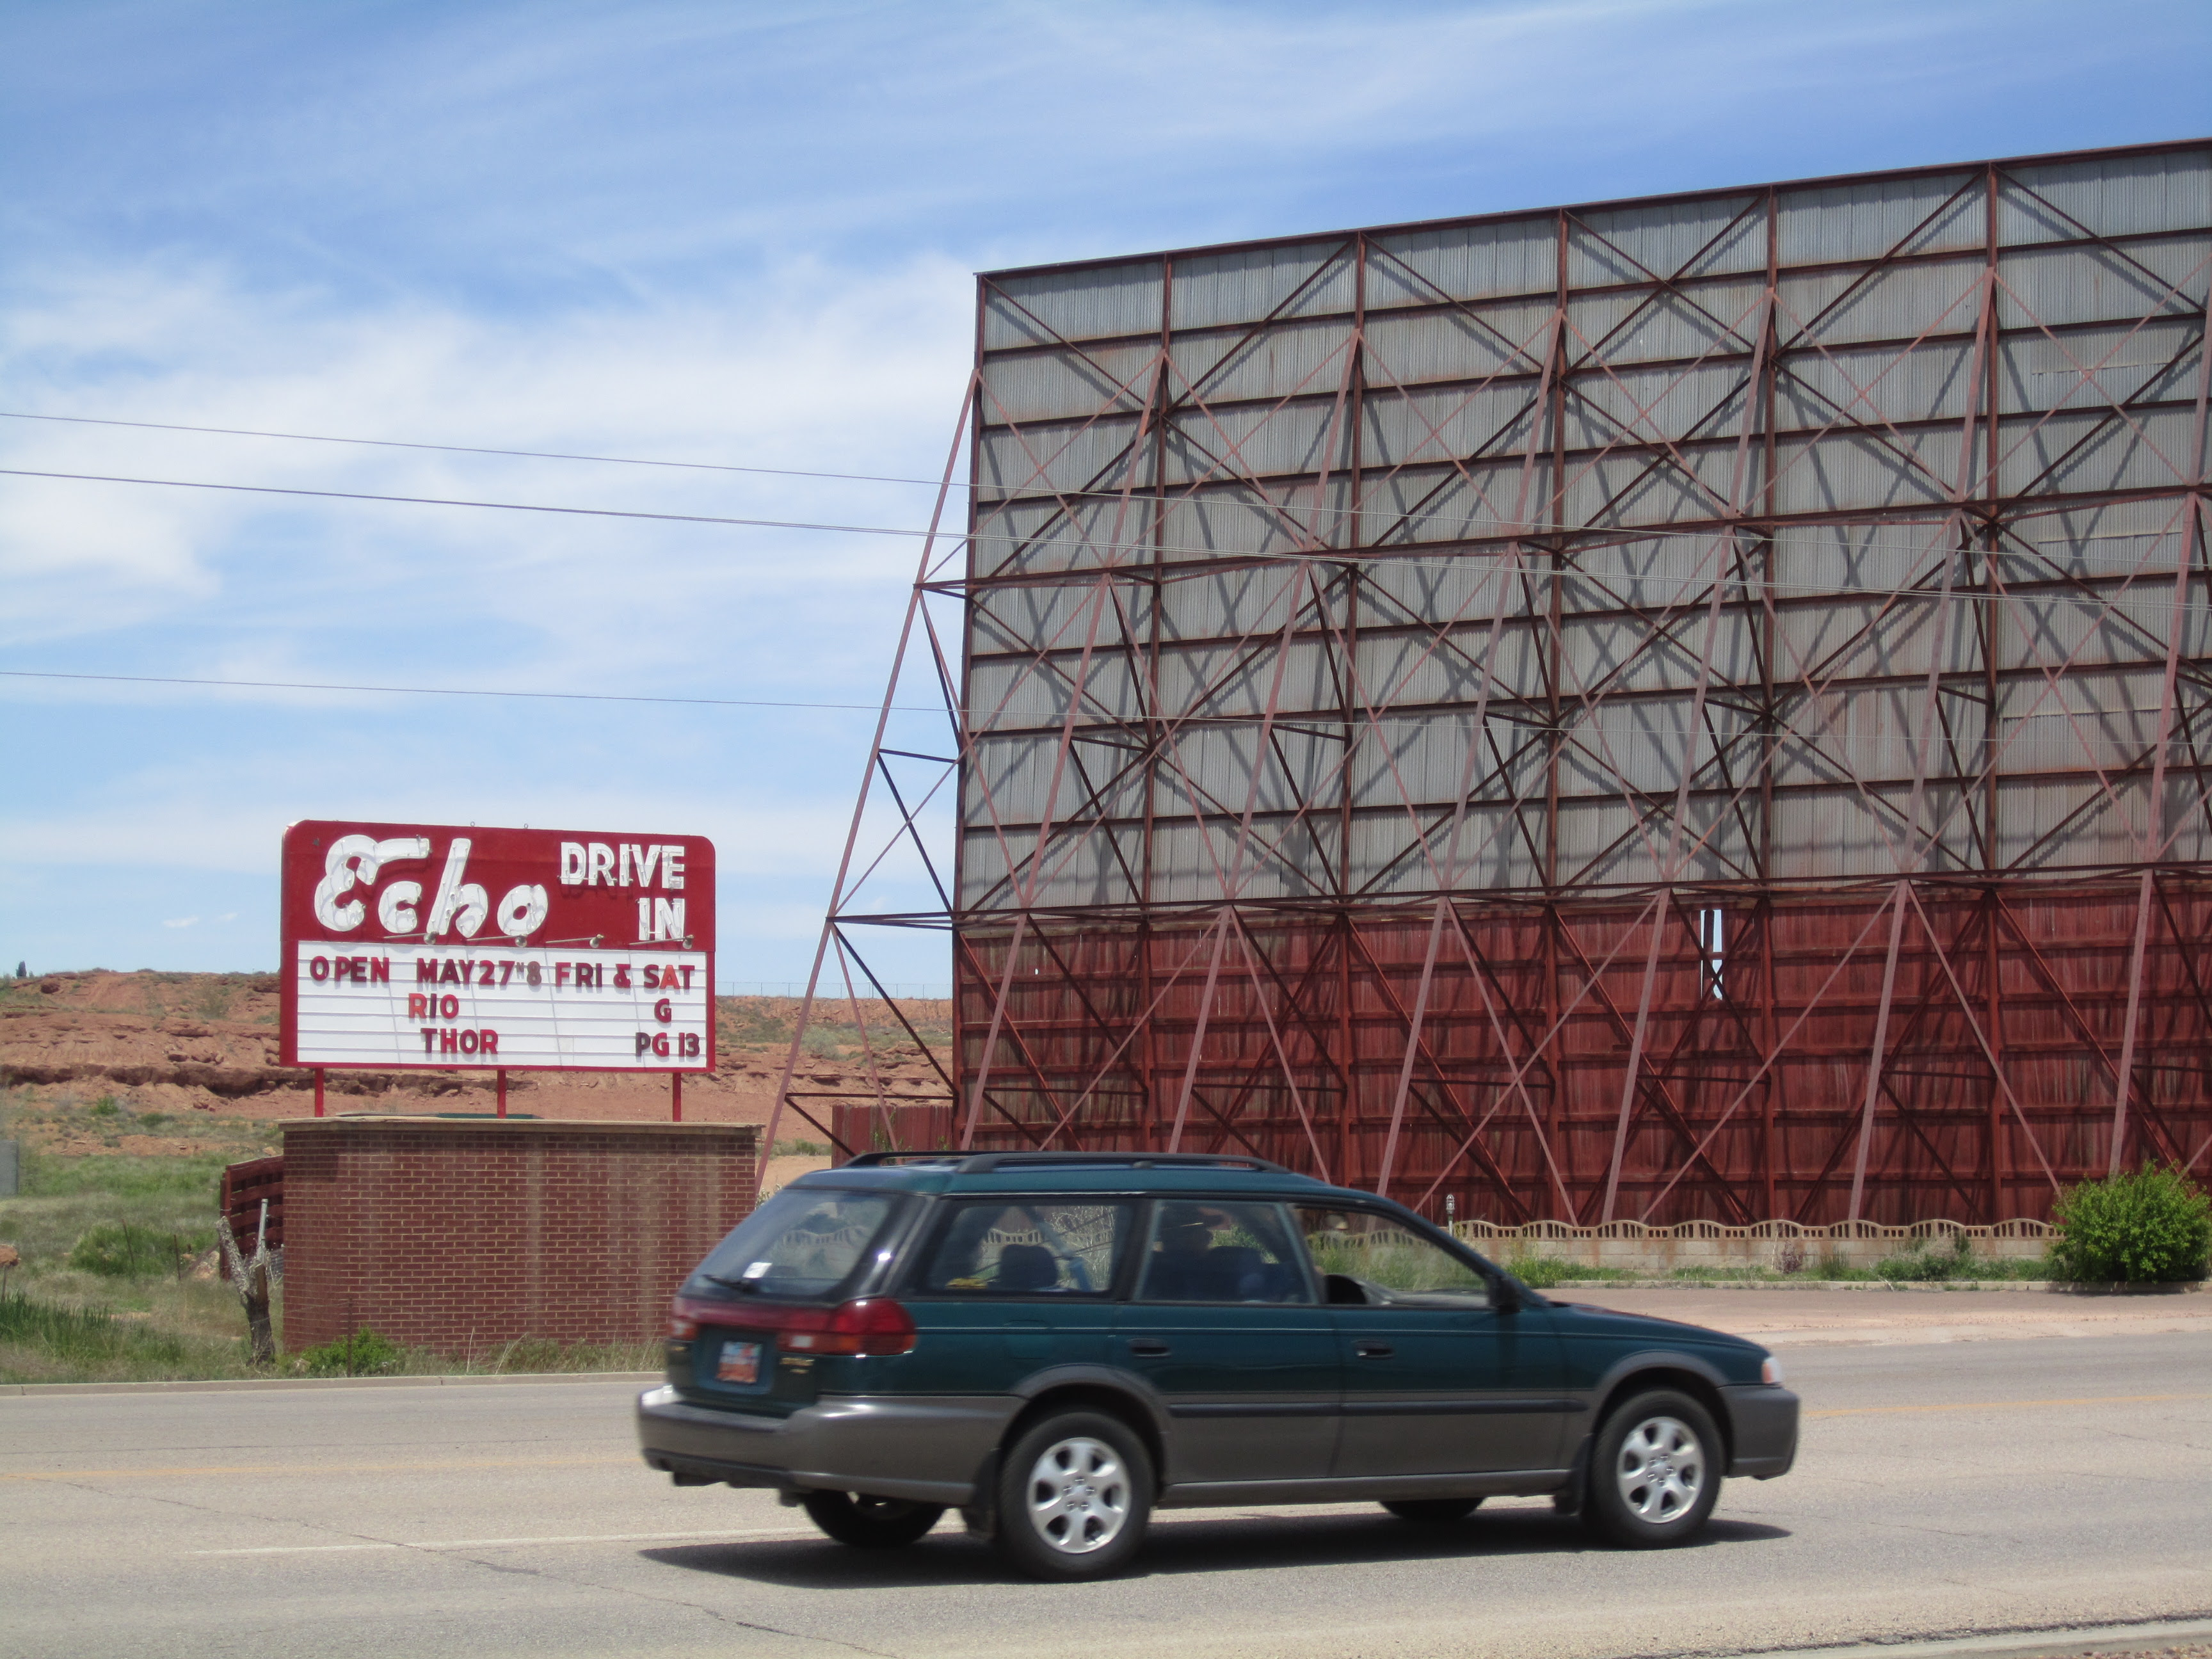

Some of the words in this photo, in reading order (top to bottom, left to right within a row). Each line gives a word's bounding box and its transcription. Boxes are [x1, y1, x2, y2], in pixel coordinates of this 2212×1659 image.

[560, 841, 685, 890] DRIVE
[314, 834, 548, 938] Echo
[638, 897, 685, 942] IN
[310, 956, 390, 982] OPEN
[555, 962, 602, 988] FRI
[613, 963, 631, 988] &
[643, 964, 695, 990] SAT
[408, 993, 460, 1019] RIO
[653, 998, 672, 1023] G
[421, 1027, 499, 1054] THOR
